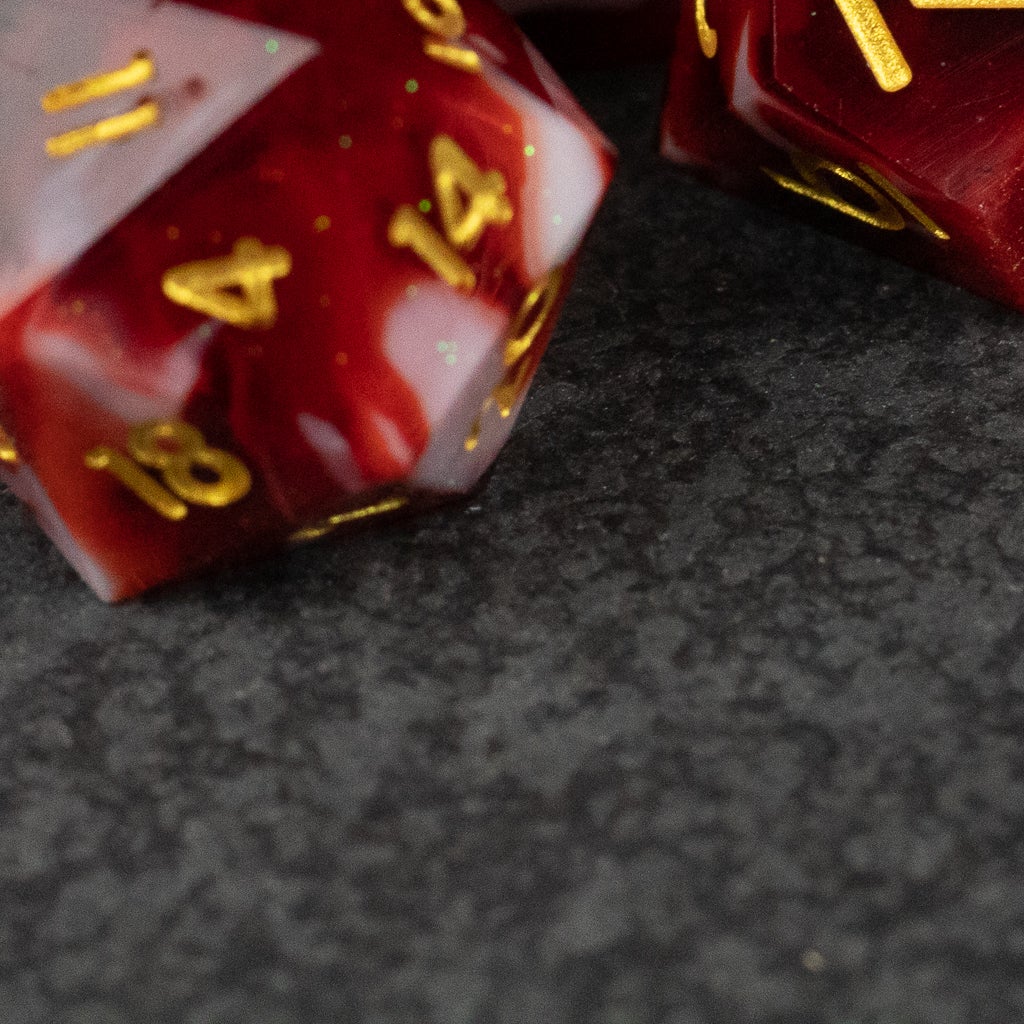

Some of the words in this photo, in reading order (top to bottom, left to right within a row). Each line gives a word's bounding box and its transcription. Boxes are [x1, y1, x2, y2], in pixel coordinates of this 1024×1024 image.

[42, 59, 160, 159] 11
[388, 133, 514, 291] 14
[162, 236, 293, 329] 4
[85, 418, 253, 522] 18
